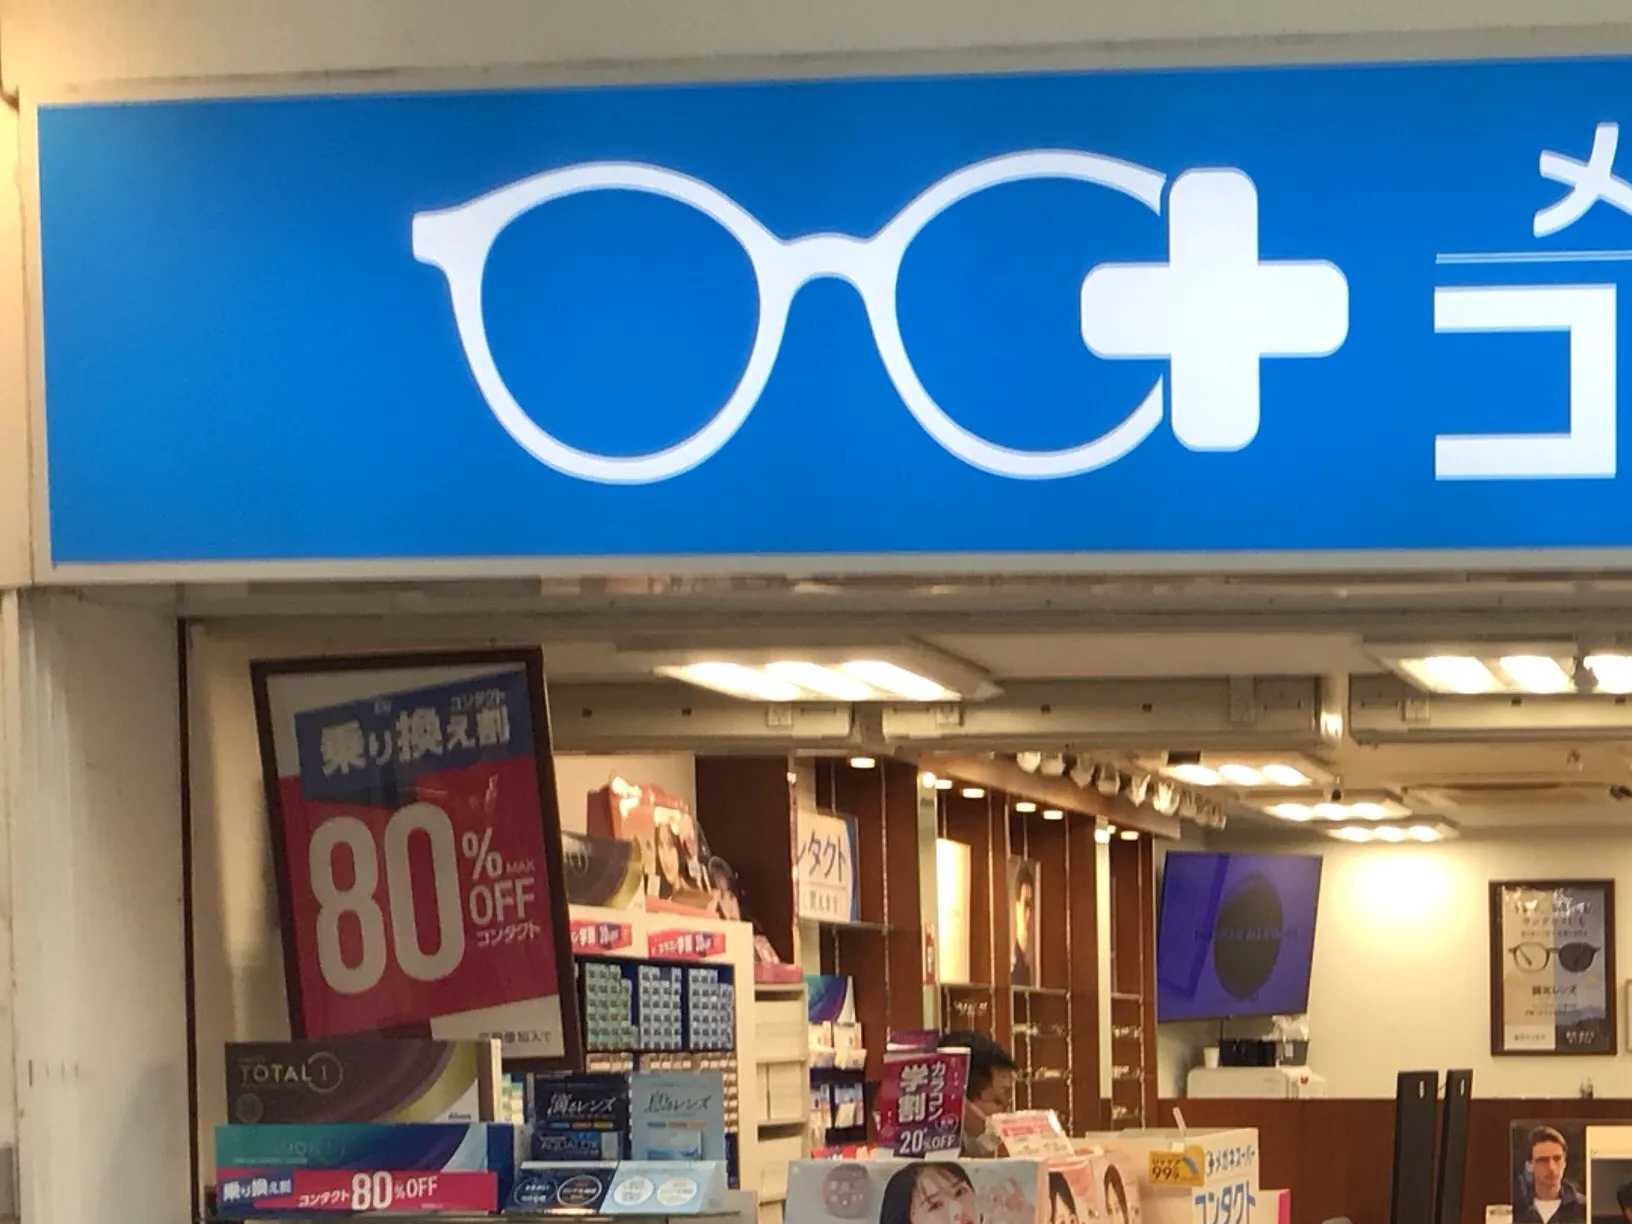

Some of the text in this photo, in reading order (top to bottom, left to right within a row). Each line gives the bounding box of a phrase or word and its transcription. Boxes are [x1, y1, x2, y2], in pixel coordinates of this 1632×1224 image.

[320, 704, 510, 776] 乗り換え割
[309, 802, 465, 994] 80
[469, 878, 536, 925] OFF
[476, 924, 541, 948] コンタクト
[898, 1063, 929, 1123] 学割
